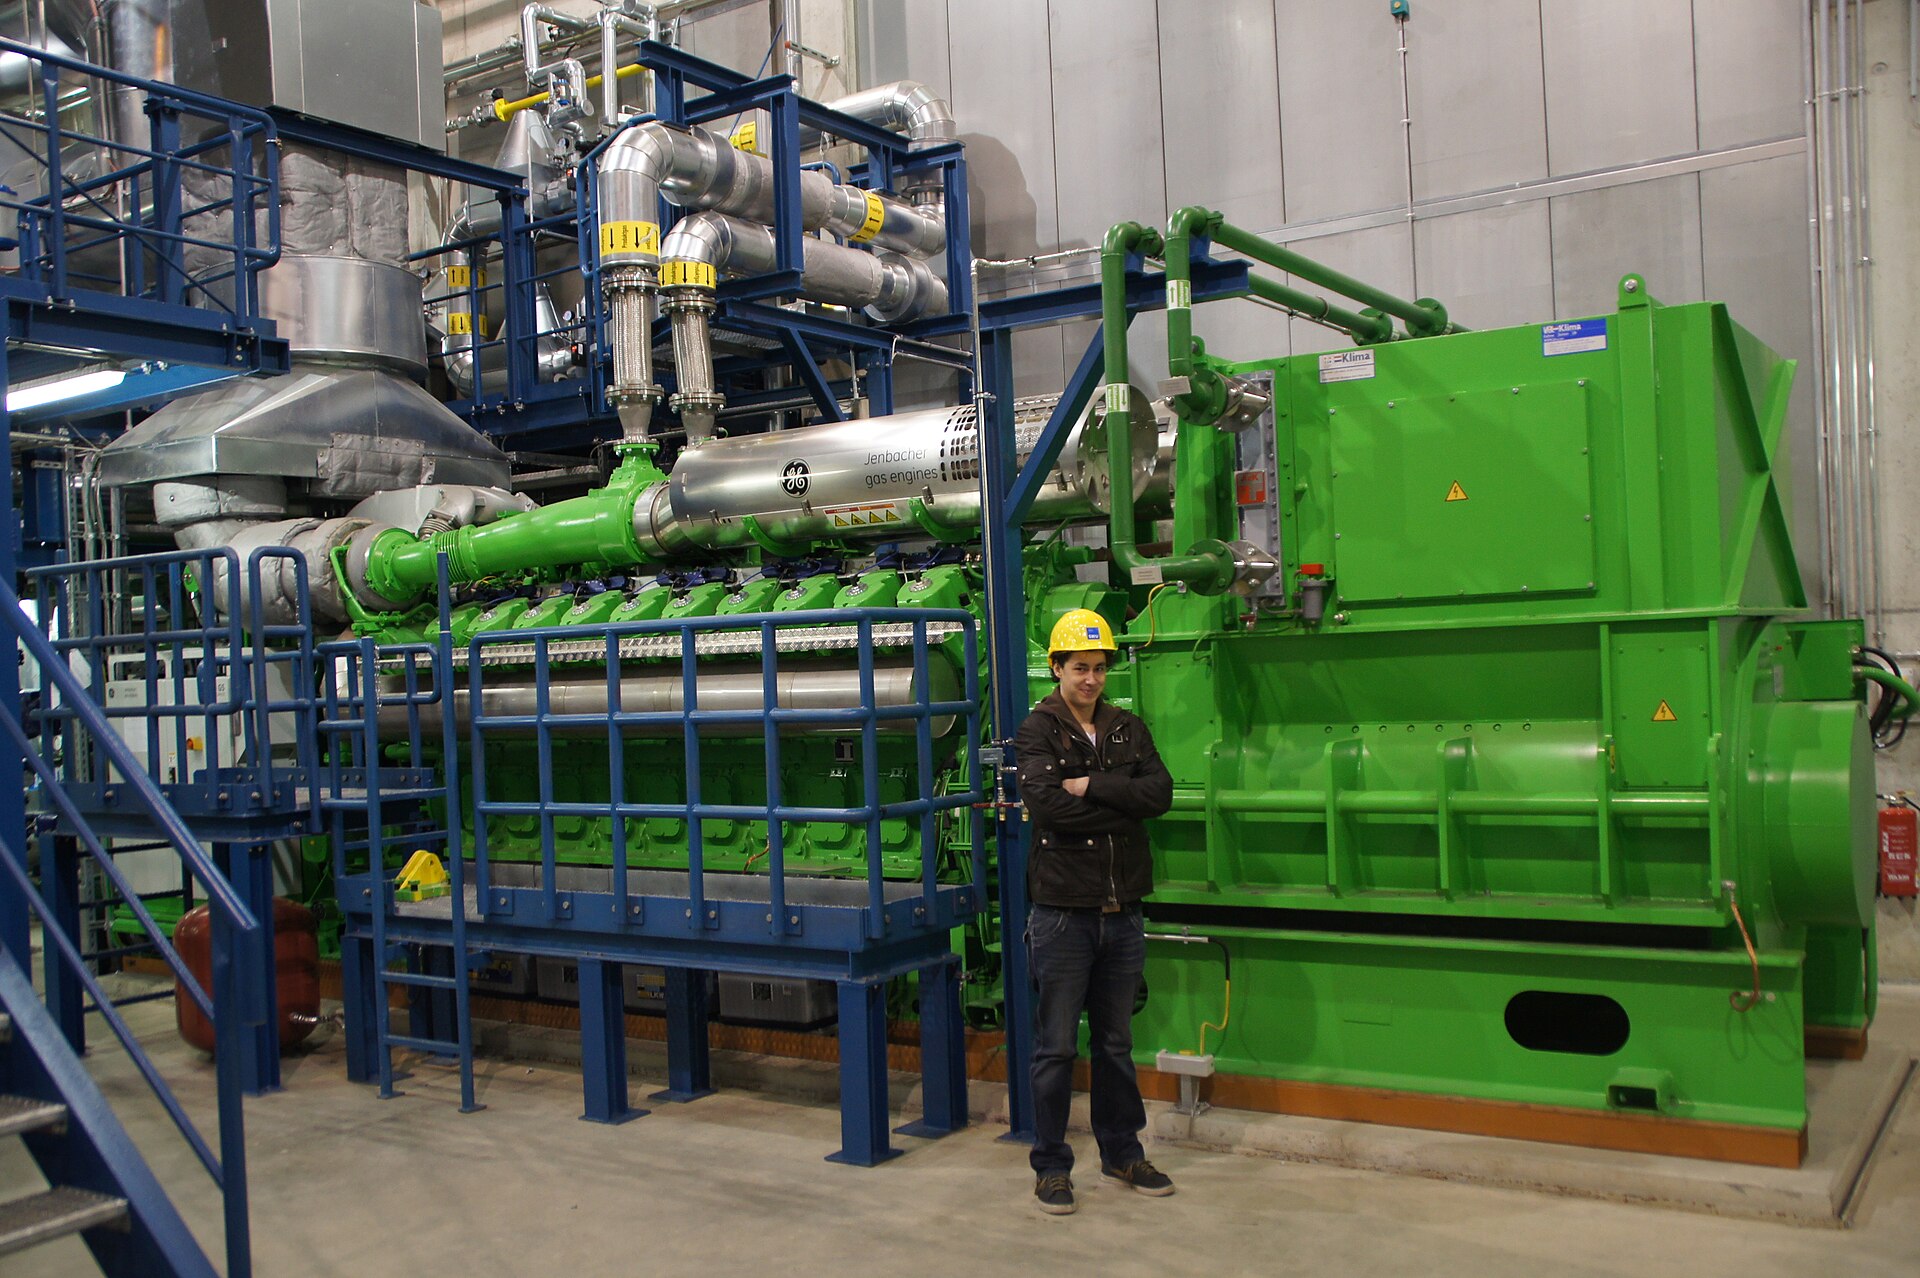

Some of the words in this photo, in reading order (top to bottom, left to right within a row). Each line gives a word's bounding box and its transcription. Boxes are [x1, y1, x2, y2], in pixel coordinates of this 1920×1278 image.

[1342, 352, 1370, 363] Klima
[864, 448, 927, 465] Jenbacher
[865, 473, 887, 489] gas
[890, 467, 938, 485] engines
